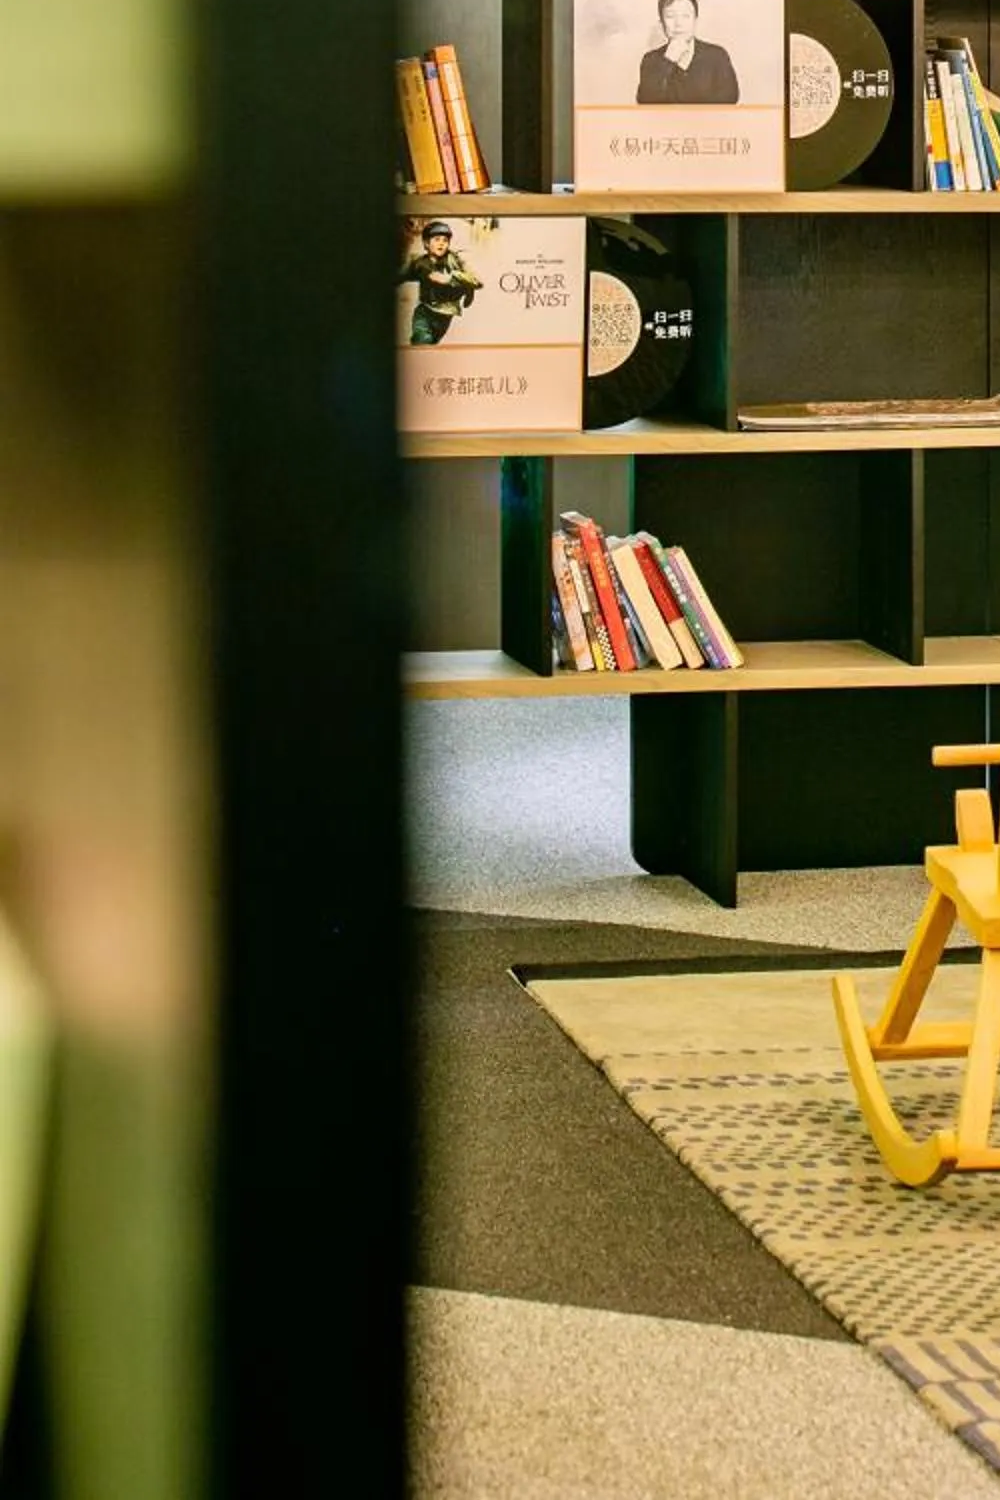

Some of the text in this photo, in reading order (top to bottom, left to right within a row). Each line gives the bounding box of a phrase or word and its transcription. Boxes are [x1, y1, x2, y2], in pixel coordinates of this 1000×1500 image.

[609, 136, 751, 156] 《易中天品三国》
[499, 272, 565, 293] OLIVER
[525, 289, 571, 308] TWIST
